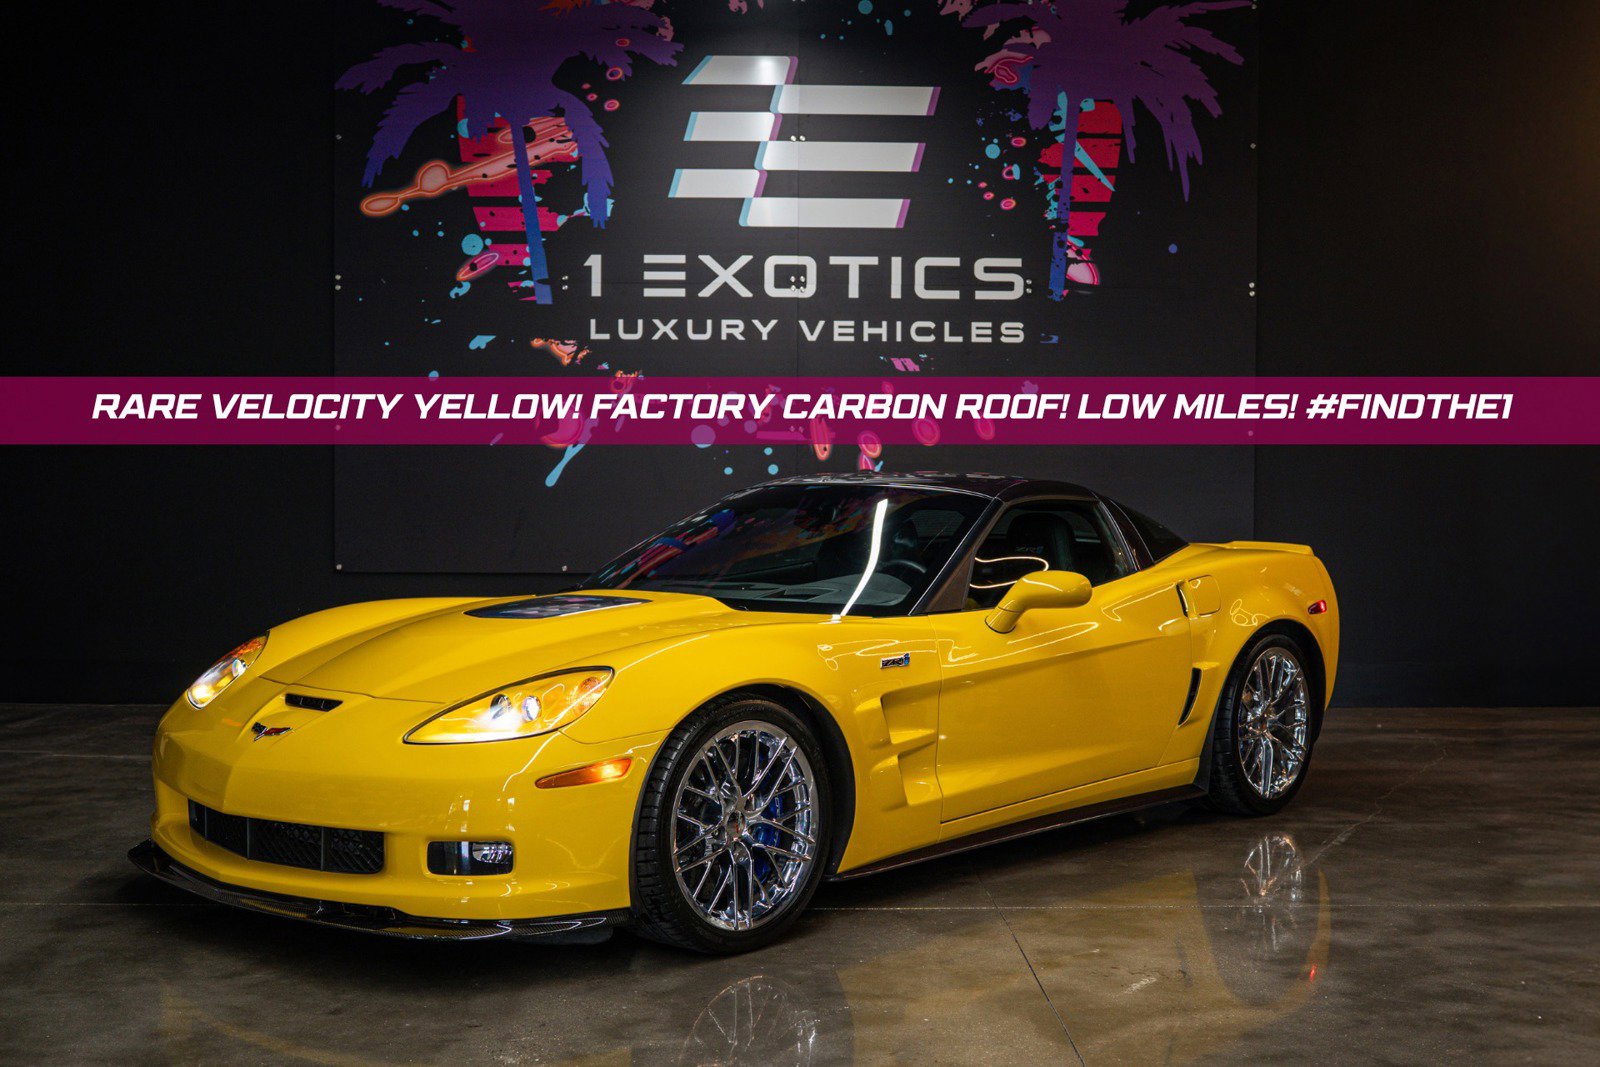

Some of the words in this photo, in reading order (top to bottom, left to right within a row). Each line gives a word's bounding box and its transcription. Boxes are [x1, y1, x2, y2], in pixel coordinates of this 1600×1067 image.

[583, 254, 602, 297] 1
[643, 254, 1025, 300] EXOTICS
[590, 318, 778, 341] LUXURY
[798, 320, 1025, 343] VEHICLES
